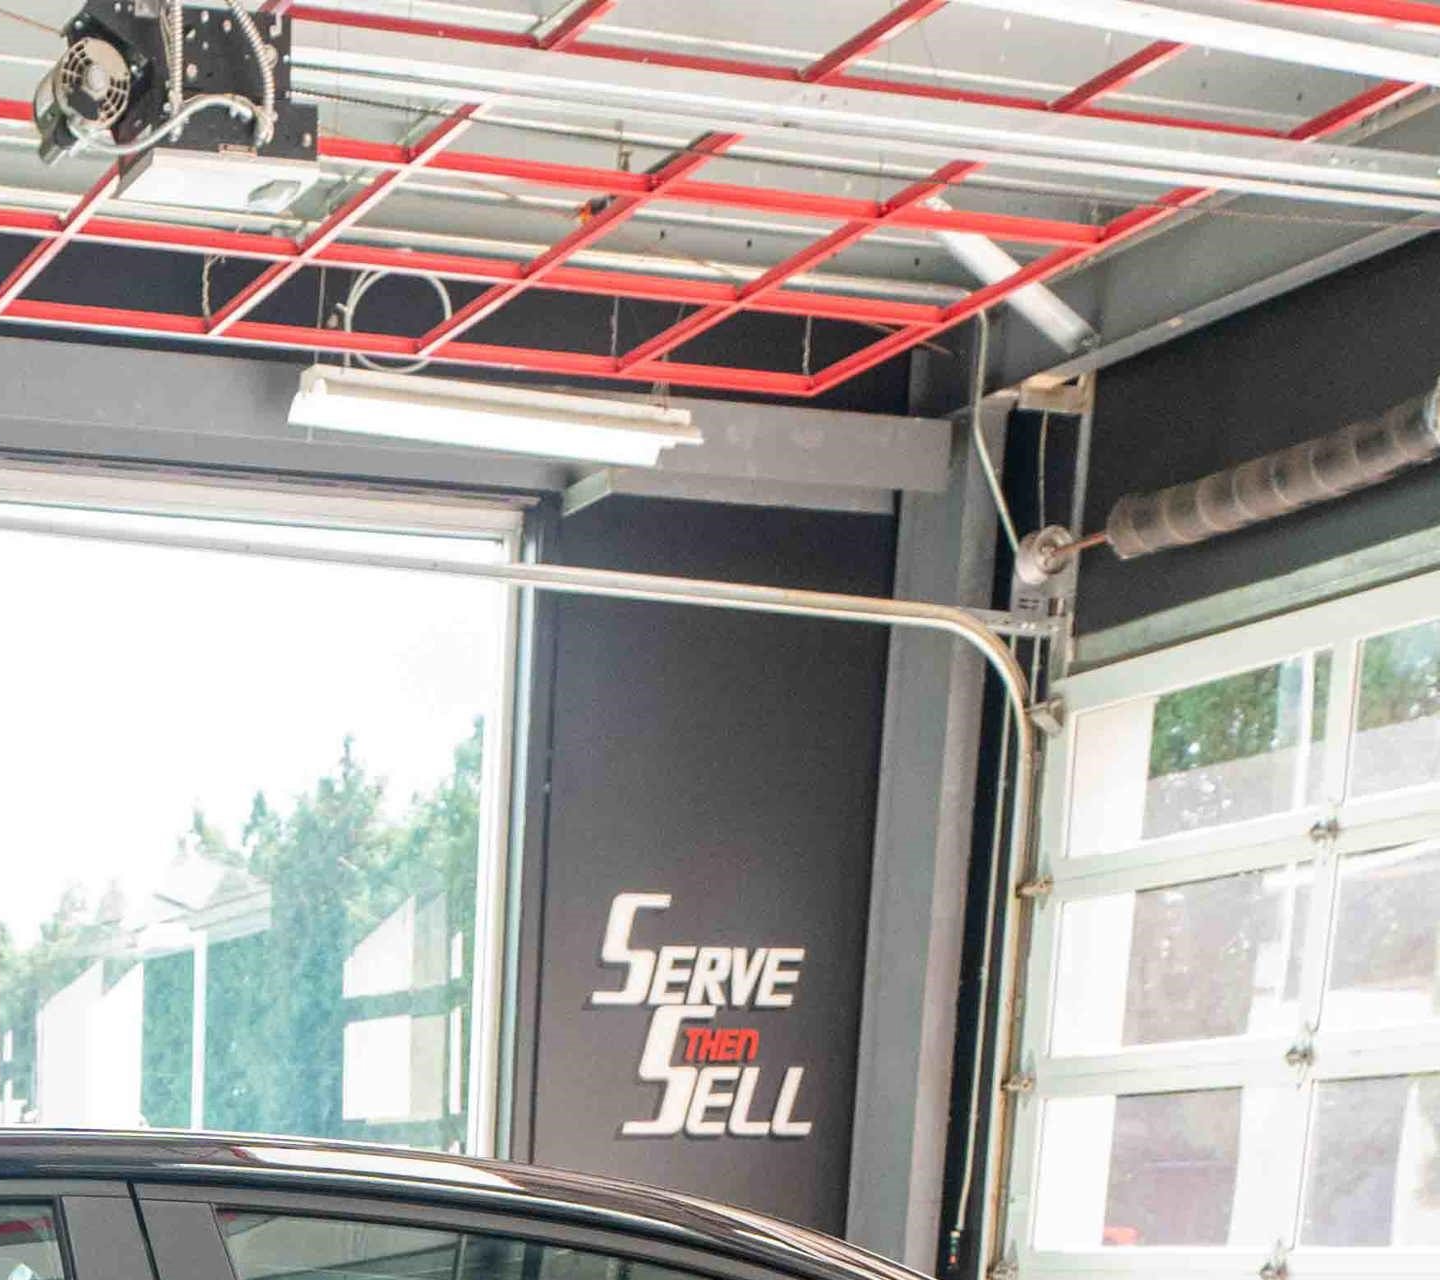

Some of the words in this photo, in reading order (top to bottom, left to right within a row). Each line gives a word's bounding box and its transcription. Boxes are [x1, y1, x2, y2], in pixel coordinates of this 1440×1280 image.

[591, 892, 805, 1005] SERVE
[621, 1005, 812, 1136] SELL
[684, 1027, 760, 1062] THEN
